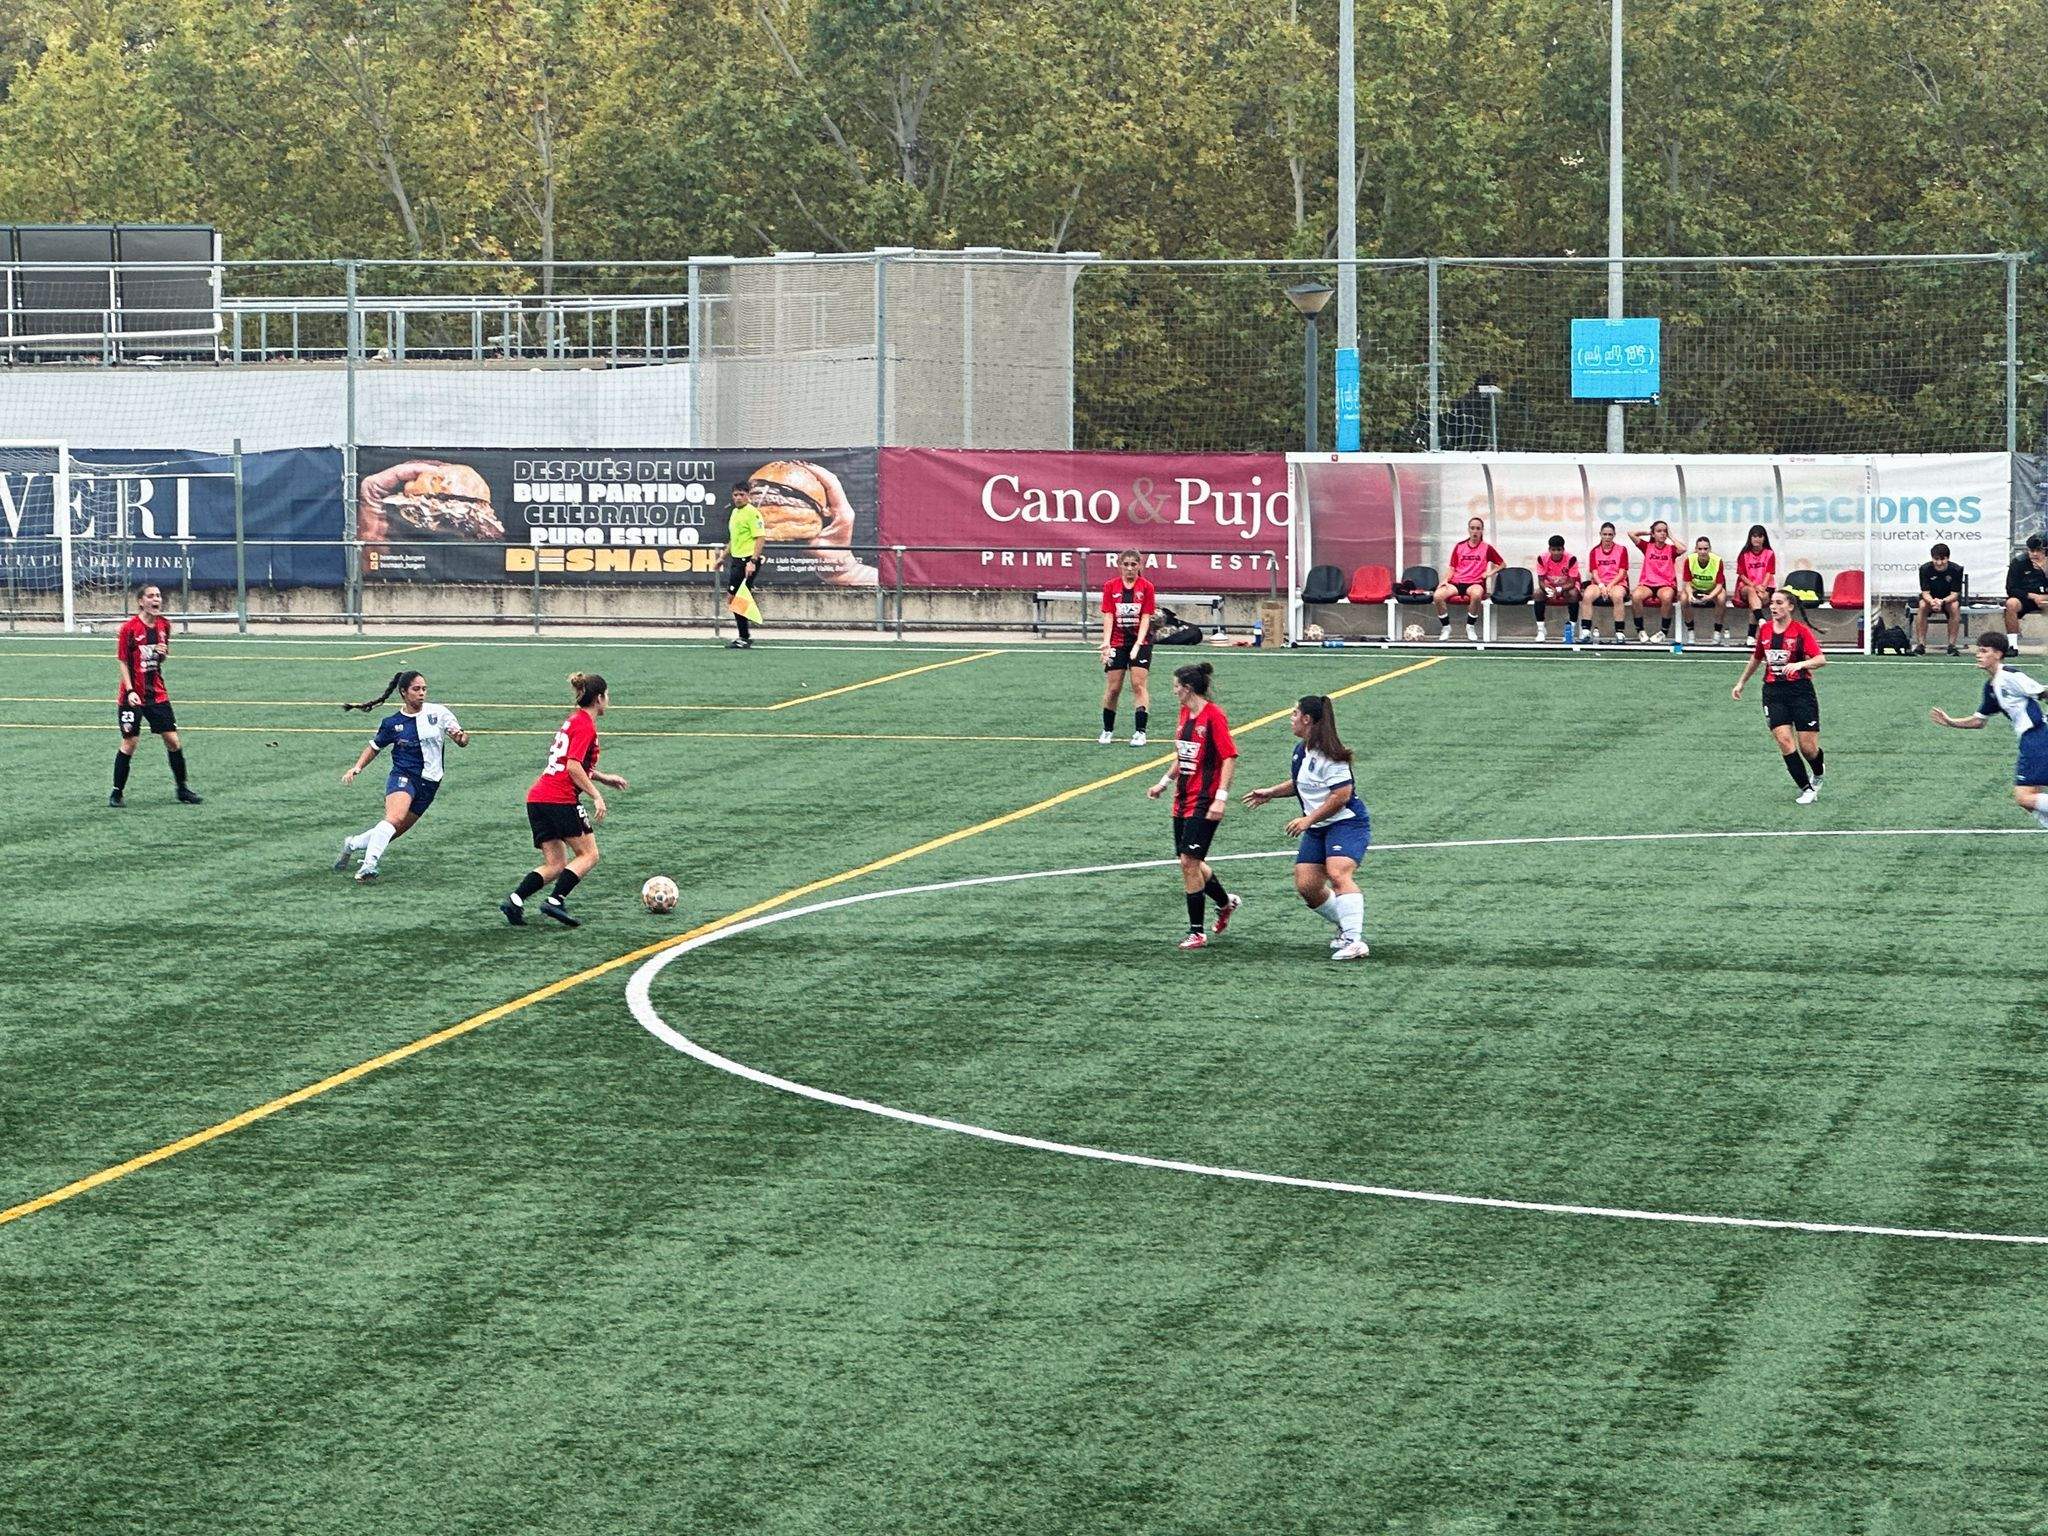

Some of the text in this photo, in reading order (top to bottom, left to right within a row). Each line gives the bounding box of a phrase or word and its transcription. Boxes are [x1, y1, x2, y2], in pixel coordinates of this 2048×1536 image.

[514, 457, 715, 481] DESPUÉS DE UN
[513, 483, 717, 506] BUEN PARTIDO,
[981, 473, 1121, 524] Cano
[673, 505, 705, 526] AL
[530, 527, 700, 546] PURO ESTILO
[1935, 529, 1982, 541] Xarxes
[981, 550, 1289, 571] PRIME RAL ESTA
[121, 711, 135, 723] 23
